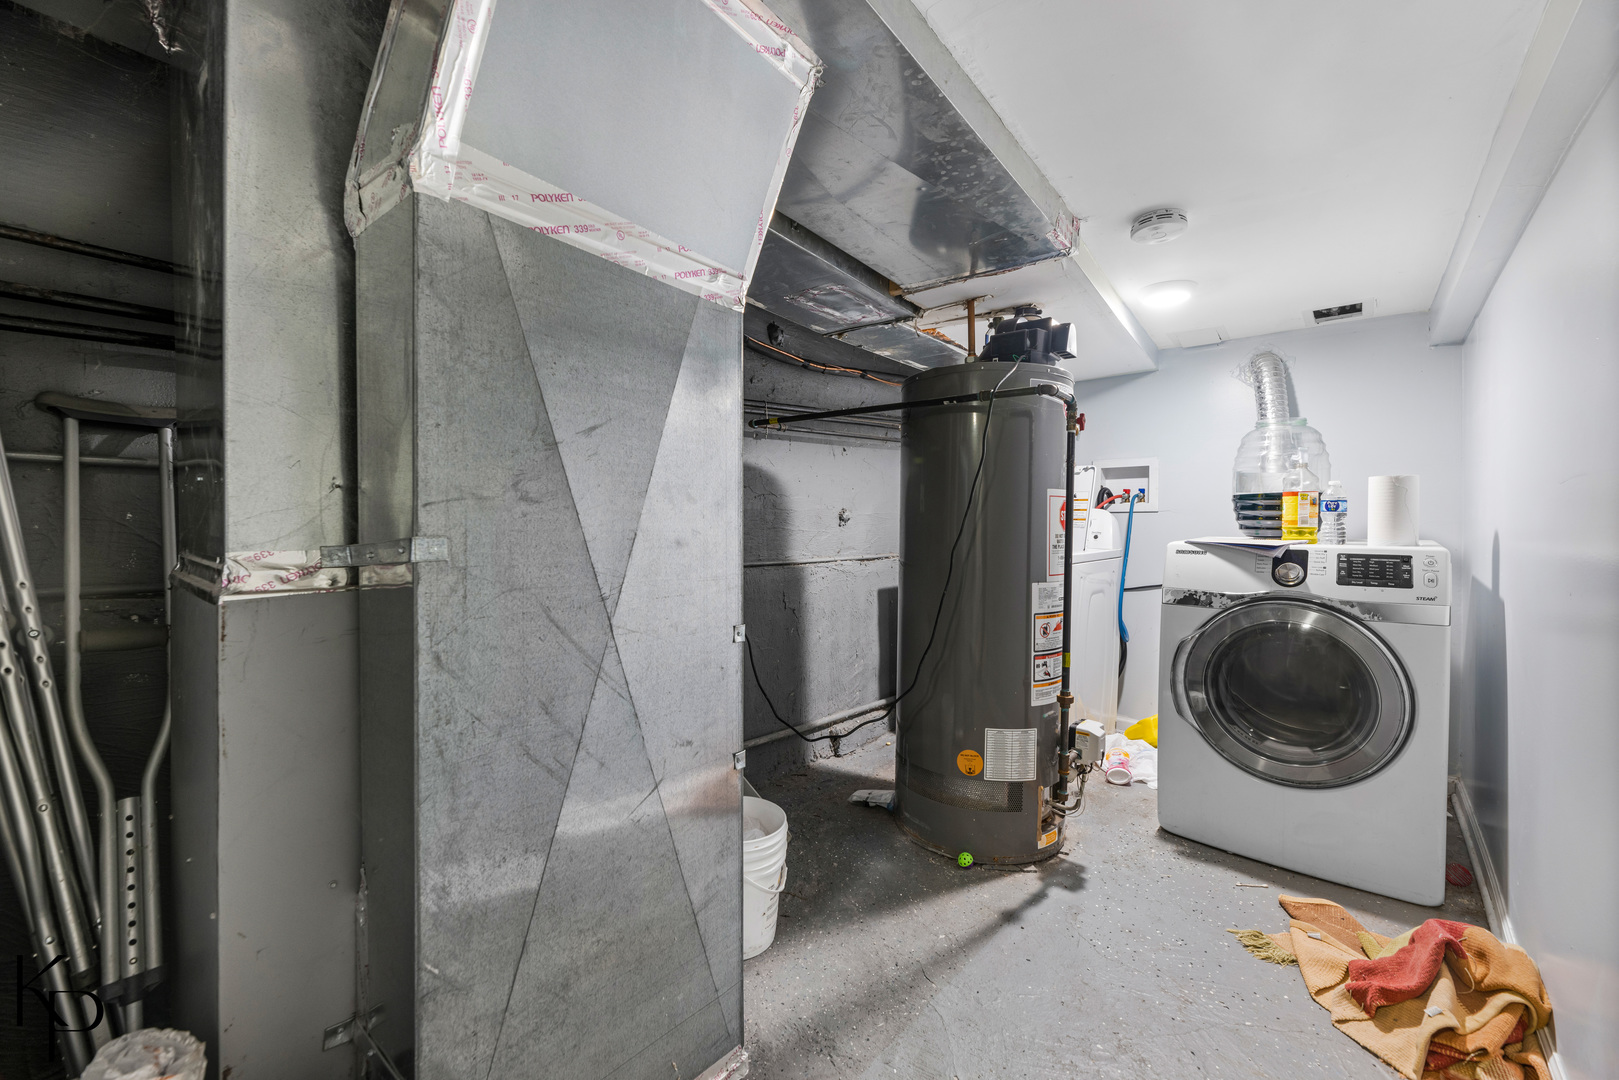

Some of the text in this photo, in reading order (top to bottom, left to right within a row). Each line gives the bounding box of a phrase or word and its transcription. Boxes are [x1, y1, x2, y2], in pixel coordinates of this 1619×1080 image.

[431, 86, 447, 149] POLYKEN
[530, 193, 574, 203] POLYKEN
[574, 224, 588, 233] 339
[675, 269, 706, 280] POLYKEN
[280, 562, 322, 585] OLYKEN
